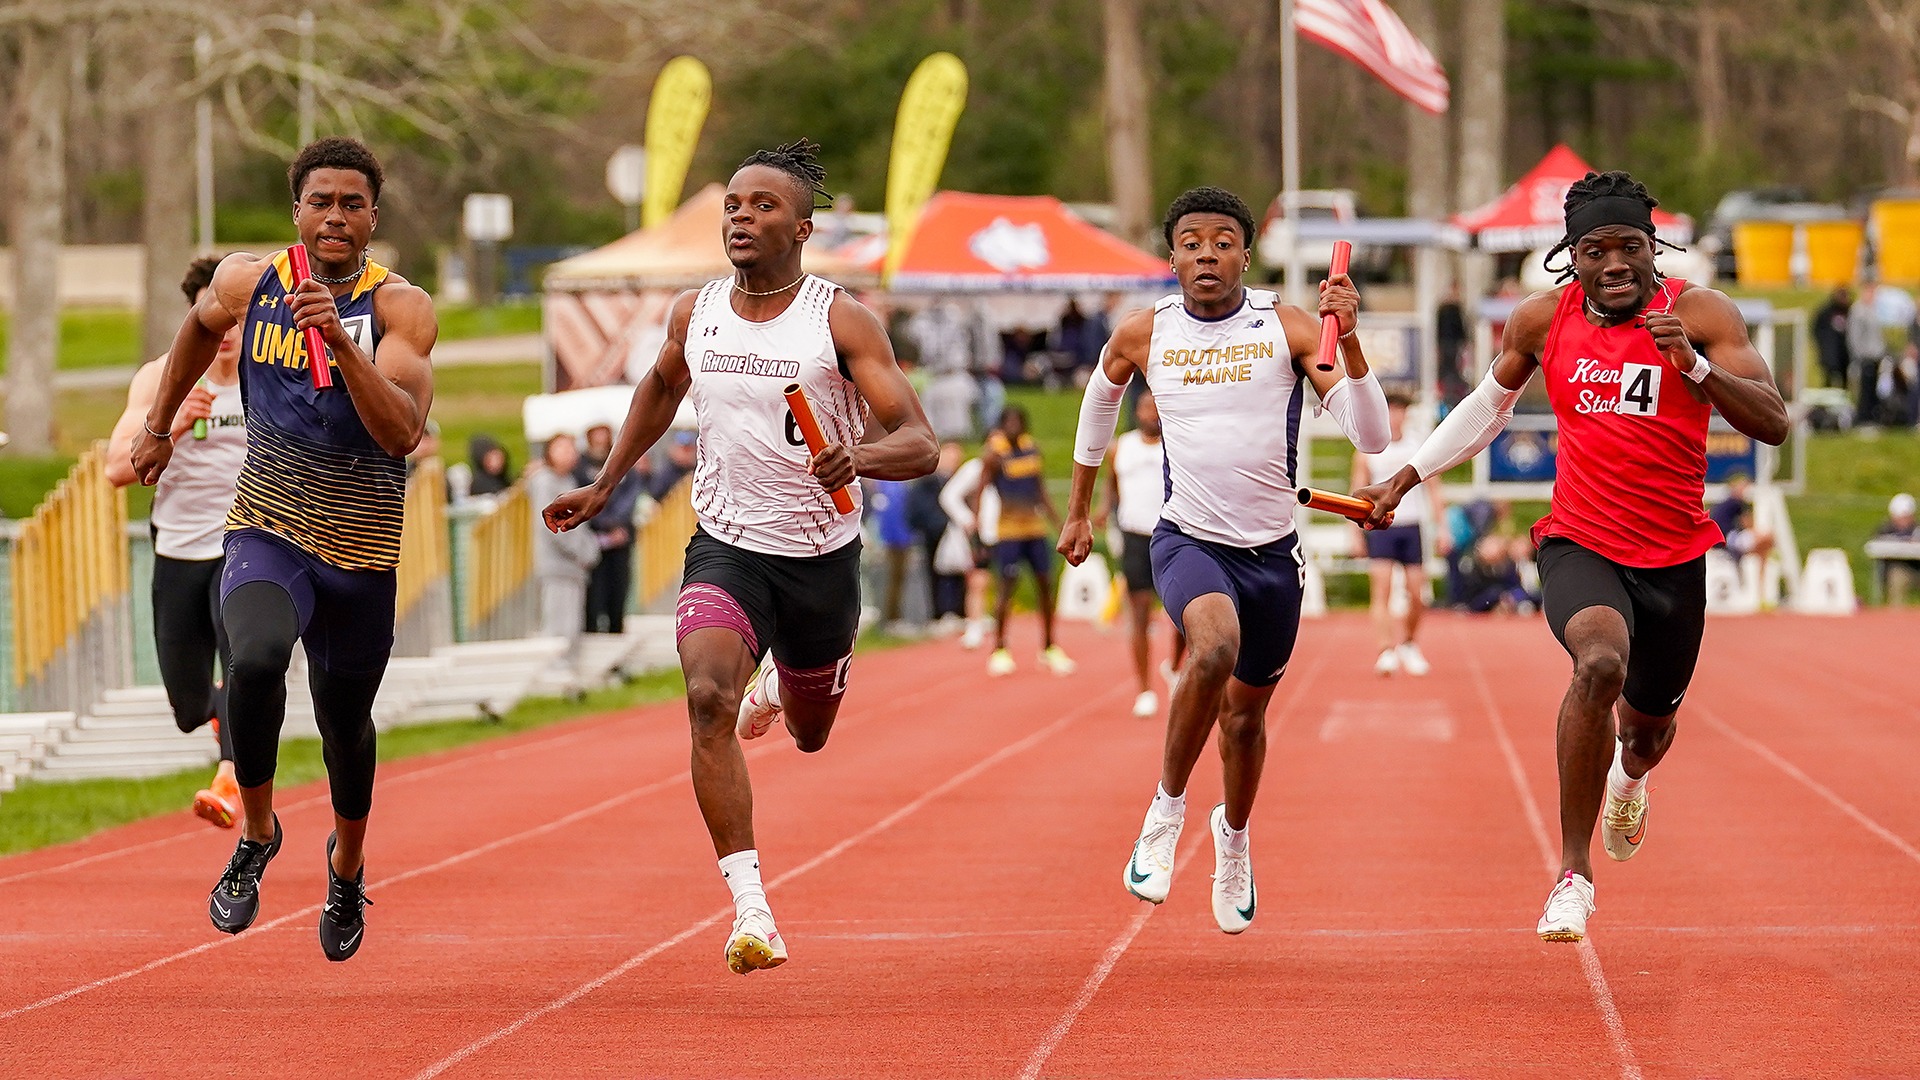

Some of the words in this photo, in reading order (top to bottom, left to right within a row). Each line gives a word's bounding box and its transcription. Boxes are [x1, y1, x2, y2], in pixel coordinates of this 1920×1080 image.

[252, 320, 337, 370] UMA
[1162, 341, 1274, 367] SOUTHERN
[701, 349, 746, 374] RHODE
[745, 353, 800, 379] ISLAND
[1183, 363, 1253, 386] MAINE
[1568, 358, 1623, 384] Keen
[1574, 389, 1624, 415] State
[1624, 368, 1654, 412] 4
[784, 408, 806, 447] 6
